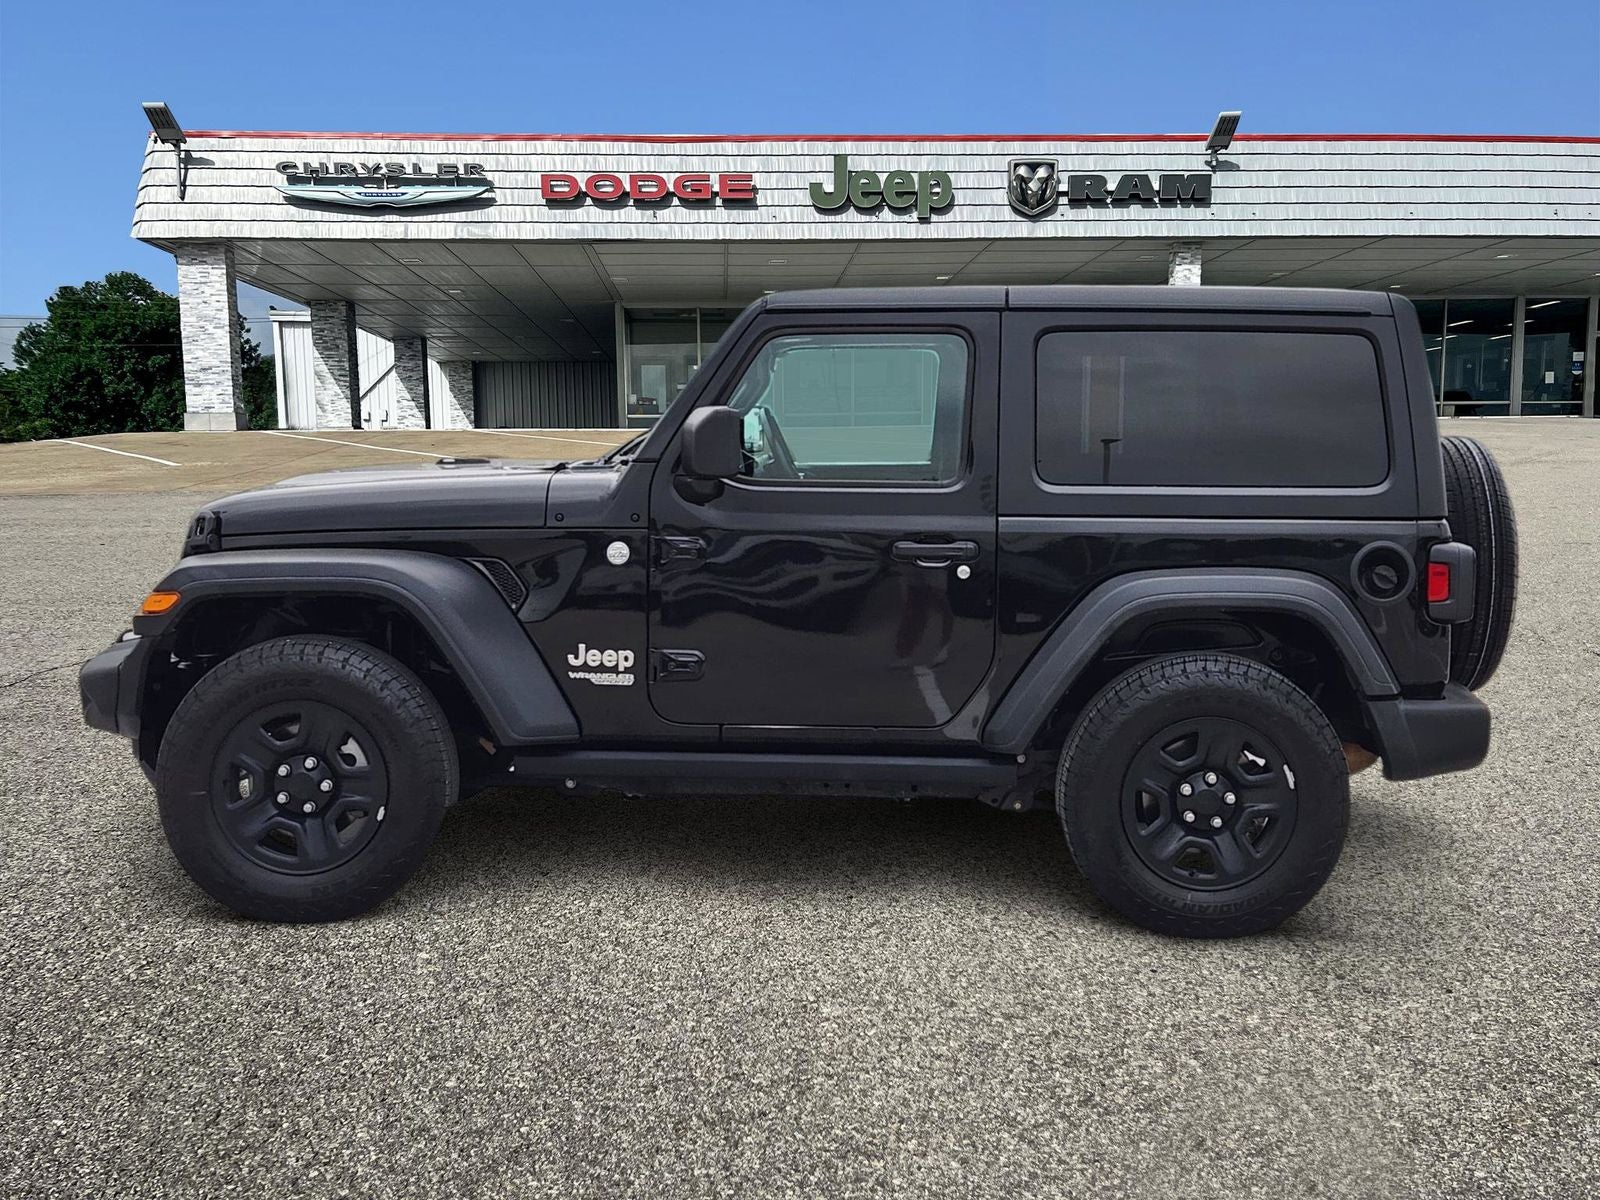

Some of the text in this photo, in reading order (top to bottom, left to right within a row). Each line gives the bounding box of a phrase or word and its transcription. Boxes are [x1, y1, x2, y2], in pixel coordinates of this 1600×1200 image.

[275, 161, 486, 177] CHRYSLER
[540, 173, 755, 200] DODGE
[809, 155, 953, 219] Jeep
[1068, 173, 1212, 200] RAM
[567, 643, 635, 672] Jeep
